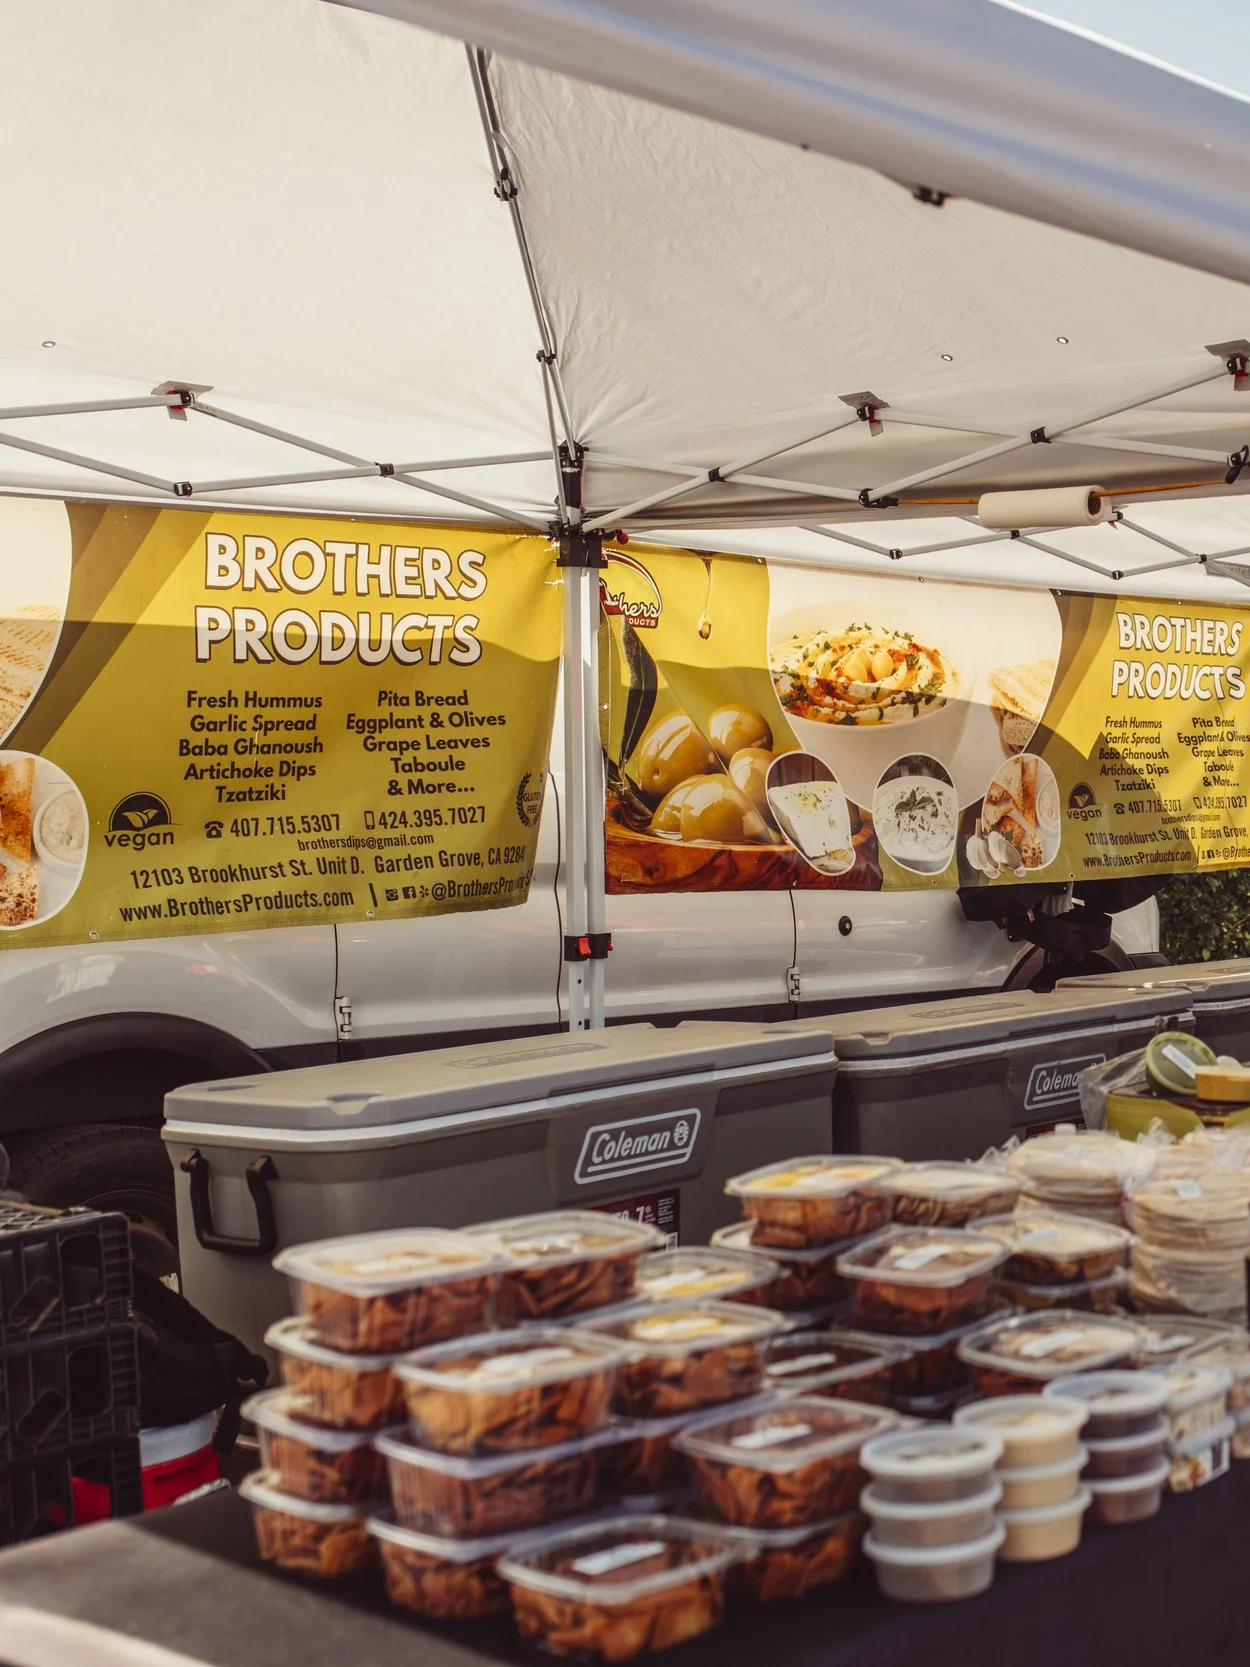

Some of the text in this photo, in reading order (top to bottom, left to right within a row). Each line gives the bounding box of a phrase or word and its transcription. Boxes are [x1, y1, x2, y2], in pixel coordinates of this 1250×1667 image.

[205, 532, 488, 601] BROTHERS
[194, 605, 482, 666] PRODUCTS
[1116, 612, 1244, 656] BROTHERS
[1111, 659, 1246, 700] PRODUCTS
[186, 690, 323, 708] Fresh Hummus
[377, 689, 469, 707] Pita Bread
[190, 714, 317, 736] Garlic Spread
[346, 710, 506, 735] Eggplant & Olives
[1105, 716, 1162, 729] Fresh Hummus
[1192, 716, 1235, 728] Pita Bread
[178, 737, 324, 757] Baba Ghanoush
[363, 734, 490, 755] Grape Leaves
[1105, 732, 1161, 747] Garlic Spread
[1177, 732, 1220, 746] Eggplant
[1219, 733, 1226, 743] &
[1098, 747, 1169, 760] Baba Ghanoush
[1192, 747, 1244, 760] Grape Leaves
[183, 760, 317, 781] Artichoke Dips
[390, 755, 466, 775] Taboule
[1100, 763, 1170, 777] Artichoke Dips
[387, 777, 475, 796] & More...
[1114, 779, 1156, 791] Tzatziki
[1203, 776, 1240, 787] & More...
[215, 784, 286, 804] Tzatziki
[1067, 808, 1102, 821] vegan
[1128, 799, 1182, 814] 407.715.5307
[229, 806, 486, 838] 407.715.5307 424.395.7027
[104, 832, 175, 850] vegan
[298, 834, 435, 851] brothersdips@gmail.com
[1109, 831, 1160, 845] Brookhurst
[1158, 829, 1172, 841] St.
[1172, 827, 1190, 840] Unit
[1190, 827, 1198, 839] D.
[1223, 825, 1248, 838] Grove,
[130, 867, 185, 889] 12103
[188, 861, 287, 884] Brookhurst
[288, 859, 313, 877] St.
[316, 856, 347, 876] Unit
[350, 856, 365, 875] D.
[374, 852, 437, 874] Garden
[439, 849, 485, 869] Grove,
[487, 847, 502, 865] CA
[1082, 850, 1192, 868] www.BrothersProducts.com
[119, 890, 355, 922] www.BrothersProducts.com
[1035, 1069, 1079, 1094] Colema
[592, 1131, 671, 1164] Coleman
